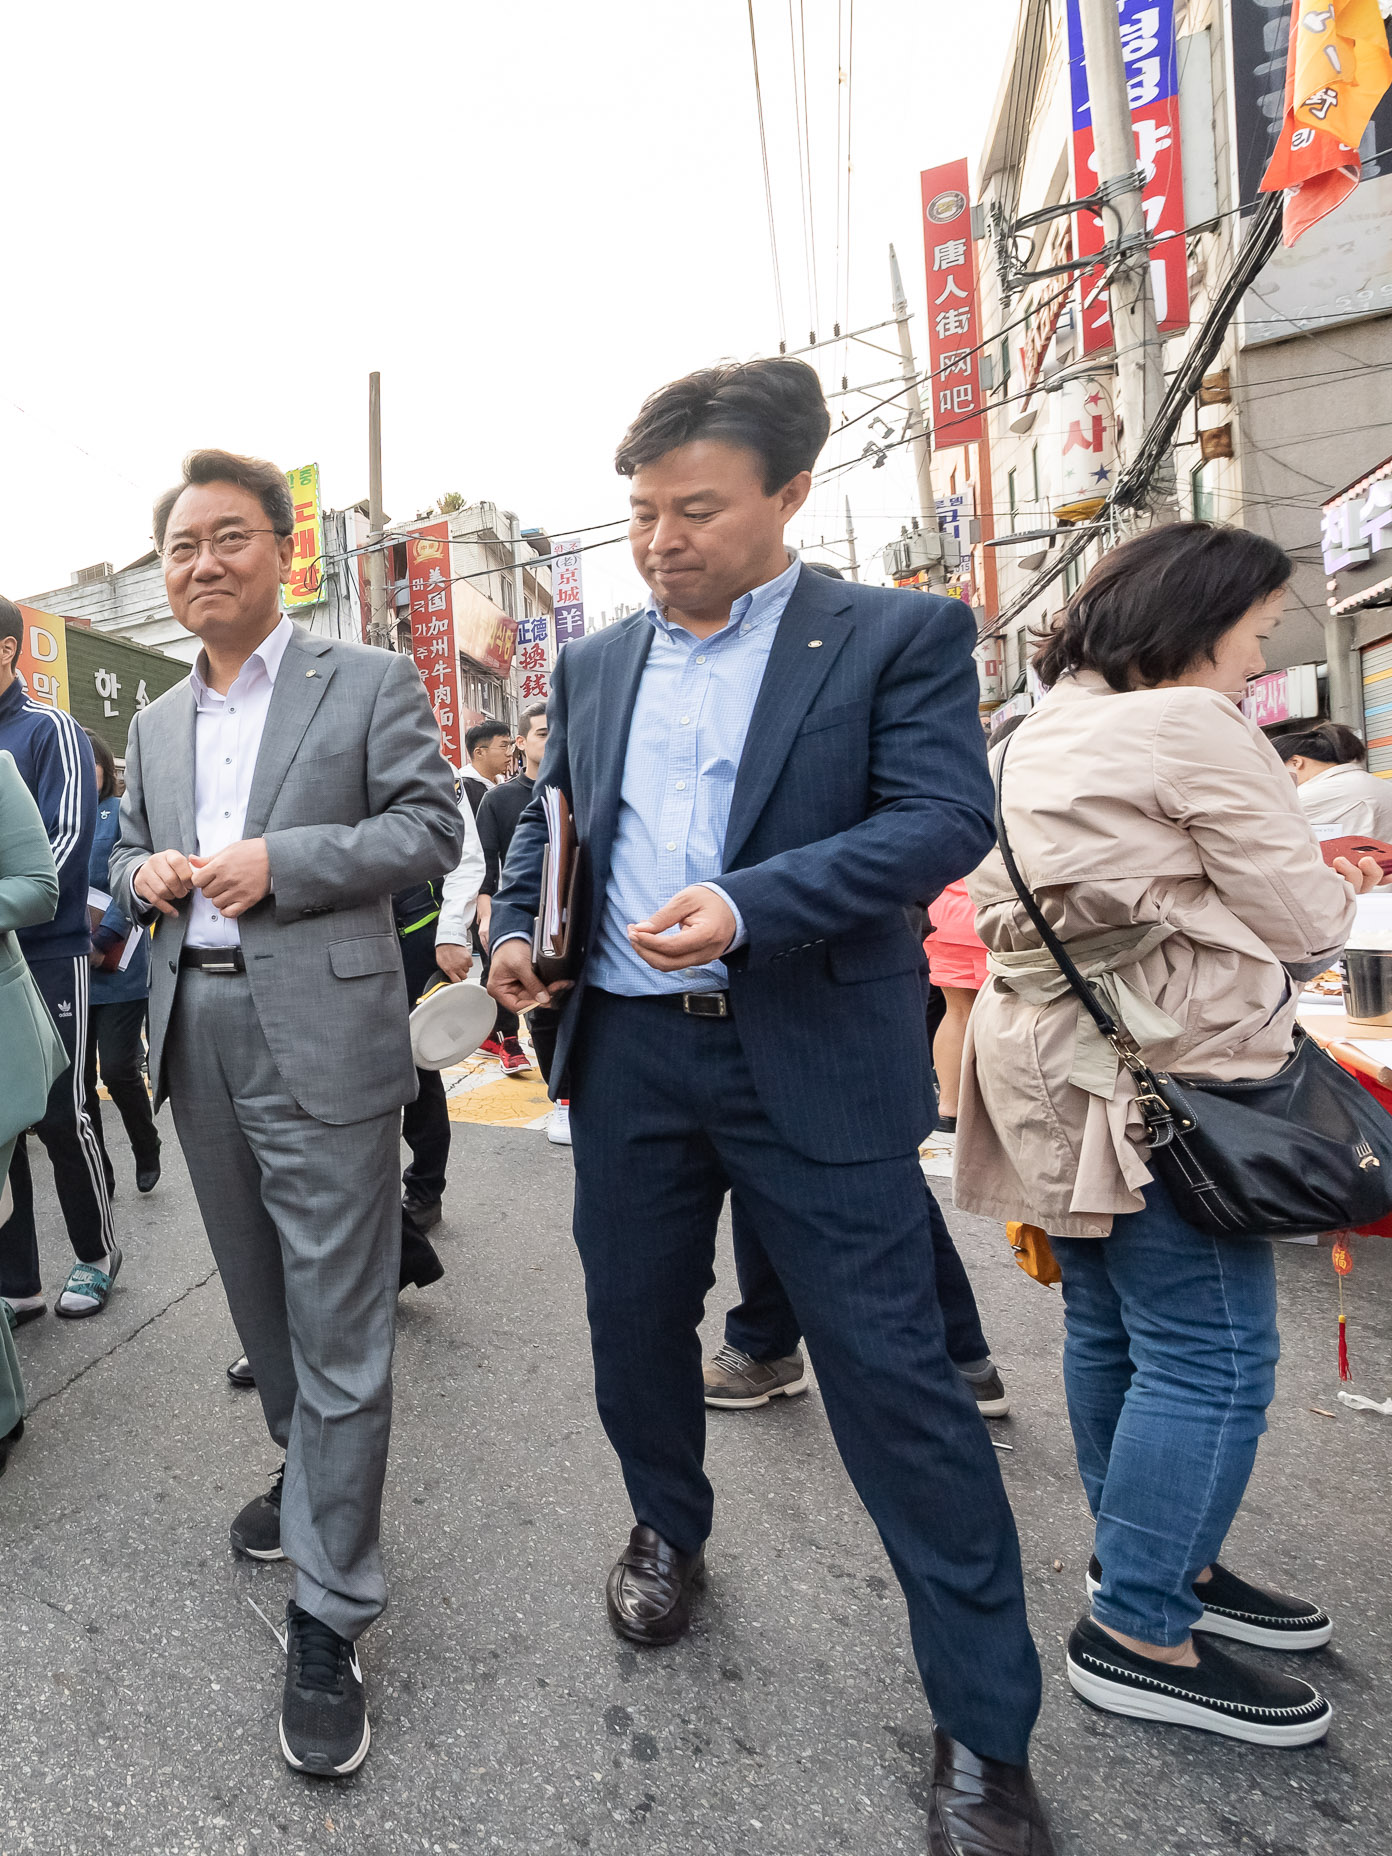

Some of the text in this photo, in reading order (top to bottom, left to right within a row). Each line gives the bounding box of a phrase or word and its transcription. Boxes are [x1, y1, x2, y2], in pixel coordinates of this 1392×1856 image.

[933, 237, 975, 414] 唐人街网吧
[1062, 414, 1106, 457] 사
[518, 617, 548, 645] 正德
